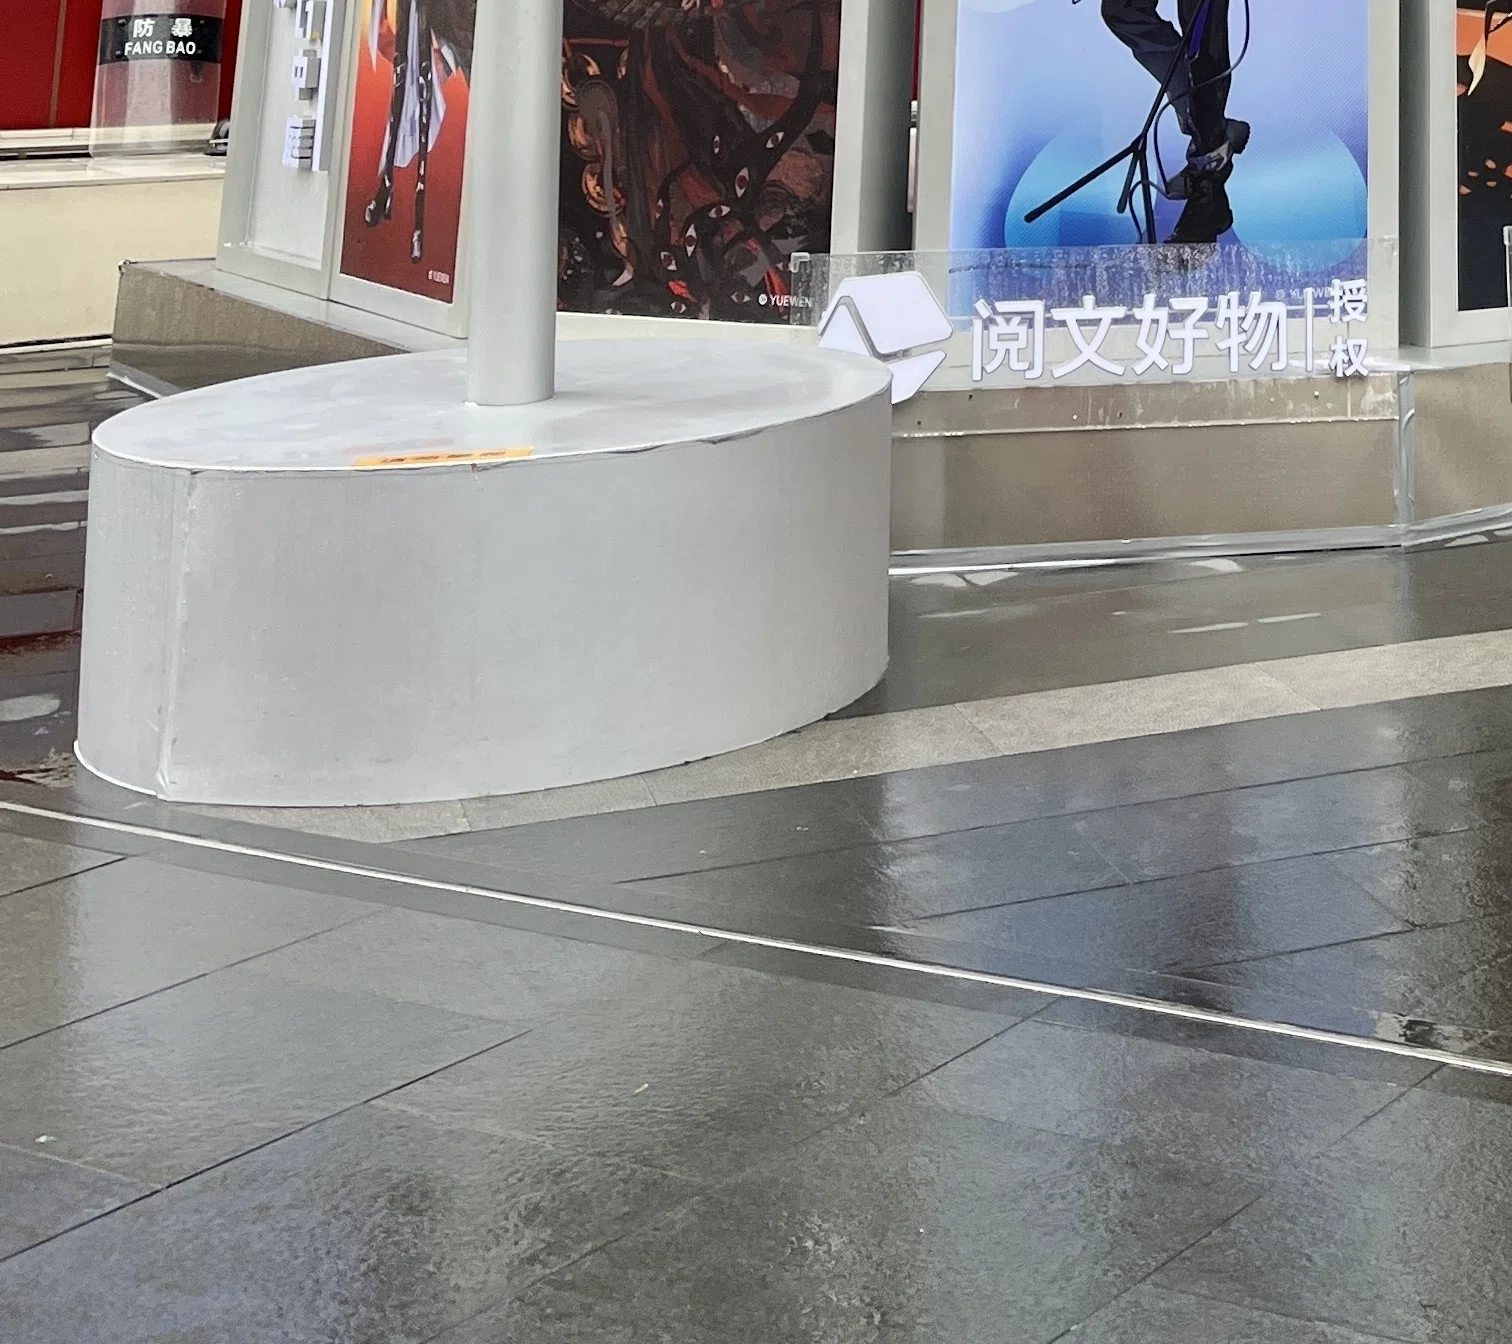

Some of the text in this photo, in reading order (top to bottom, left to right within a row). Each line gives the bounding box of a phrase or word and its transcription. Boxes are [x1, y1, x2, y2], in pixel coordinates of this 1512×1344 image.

[132, 17, 193, 38] 防暴
[124, 40, 197, 56] FANG BAO
[769, 294, 813, 308] YUEWEN
[971, 290, 1288, 382] 阅文好物
[1328, 277, 1369, 379] 授权
